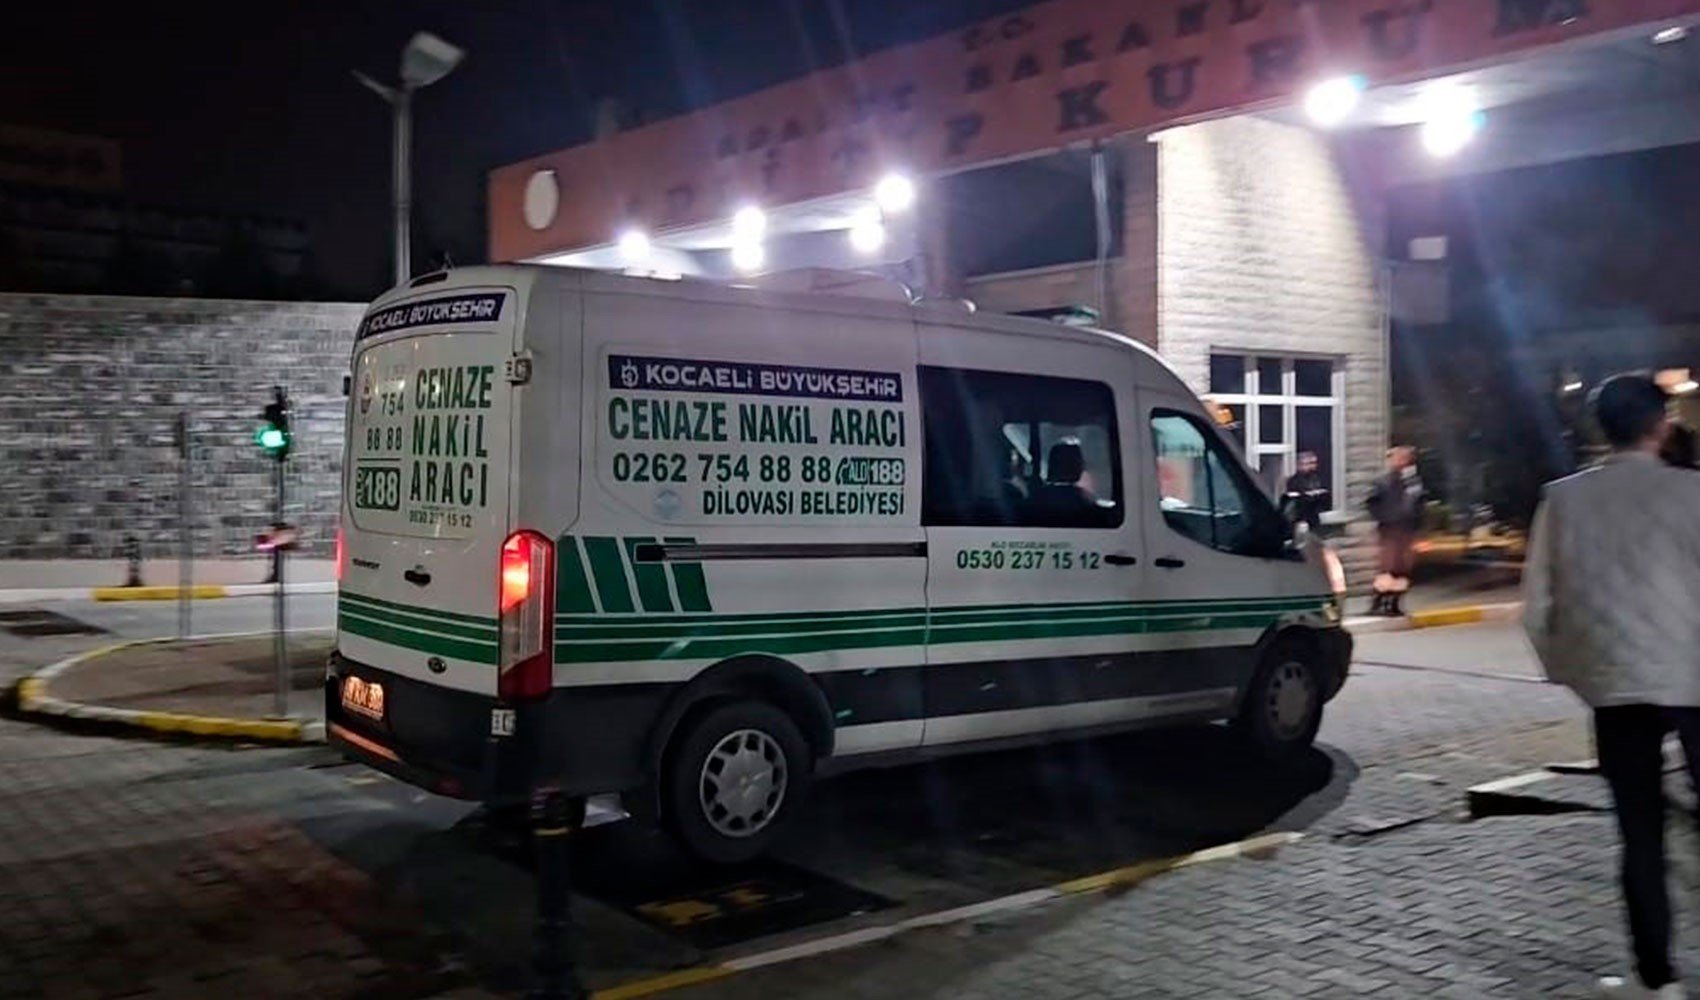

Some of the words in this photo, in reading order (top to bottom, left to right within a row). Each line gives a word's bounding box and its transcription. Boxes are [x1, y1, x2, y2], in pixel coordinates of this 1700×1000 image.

[415, 365, 494, 410] CENAZE
[381, 392, 405, 417] 754
[367, 427, 380, 451] 88
[387, 426, 402, 451] 88
[608, 397, 728, 442] CENAZE
[830, 407, 906, 447] ARACI
[410, 460, 487, 507] ARACI
[612, 453, 688, 483] 0262
[698, 453, 749, 483] 754
[759, 456, 791, 483] 88
[801, 456, 832, 483] 88
[870, 459, 904, 484] 188
[365, 471, 398, 507] 188
[956, 550, 1005, 569] 0530
[1011, 551, 1046, 569] 237
[1051, 551, 1073, 569] 15
[1079, 551, 1100, 570] 12
